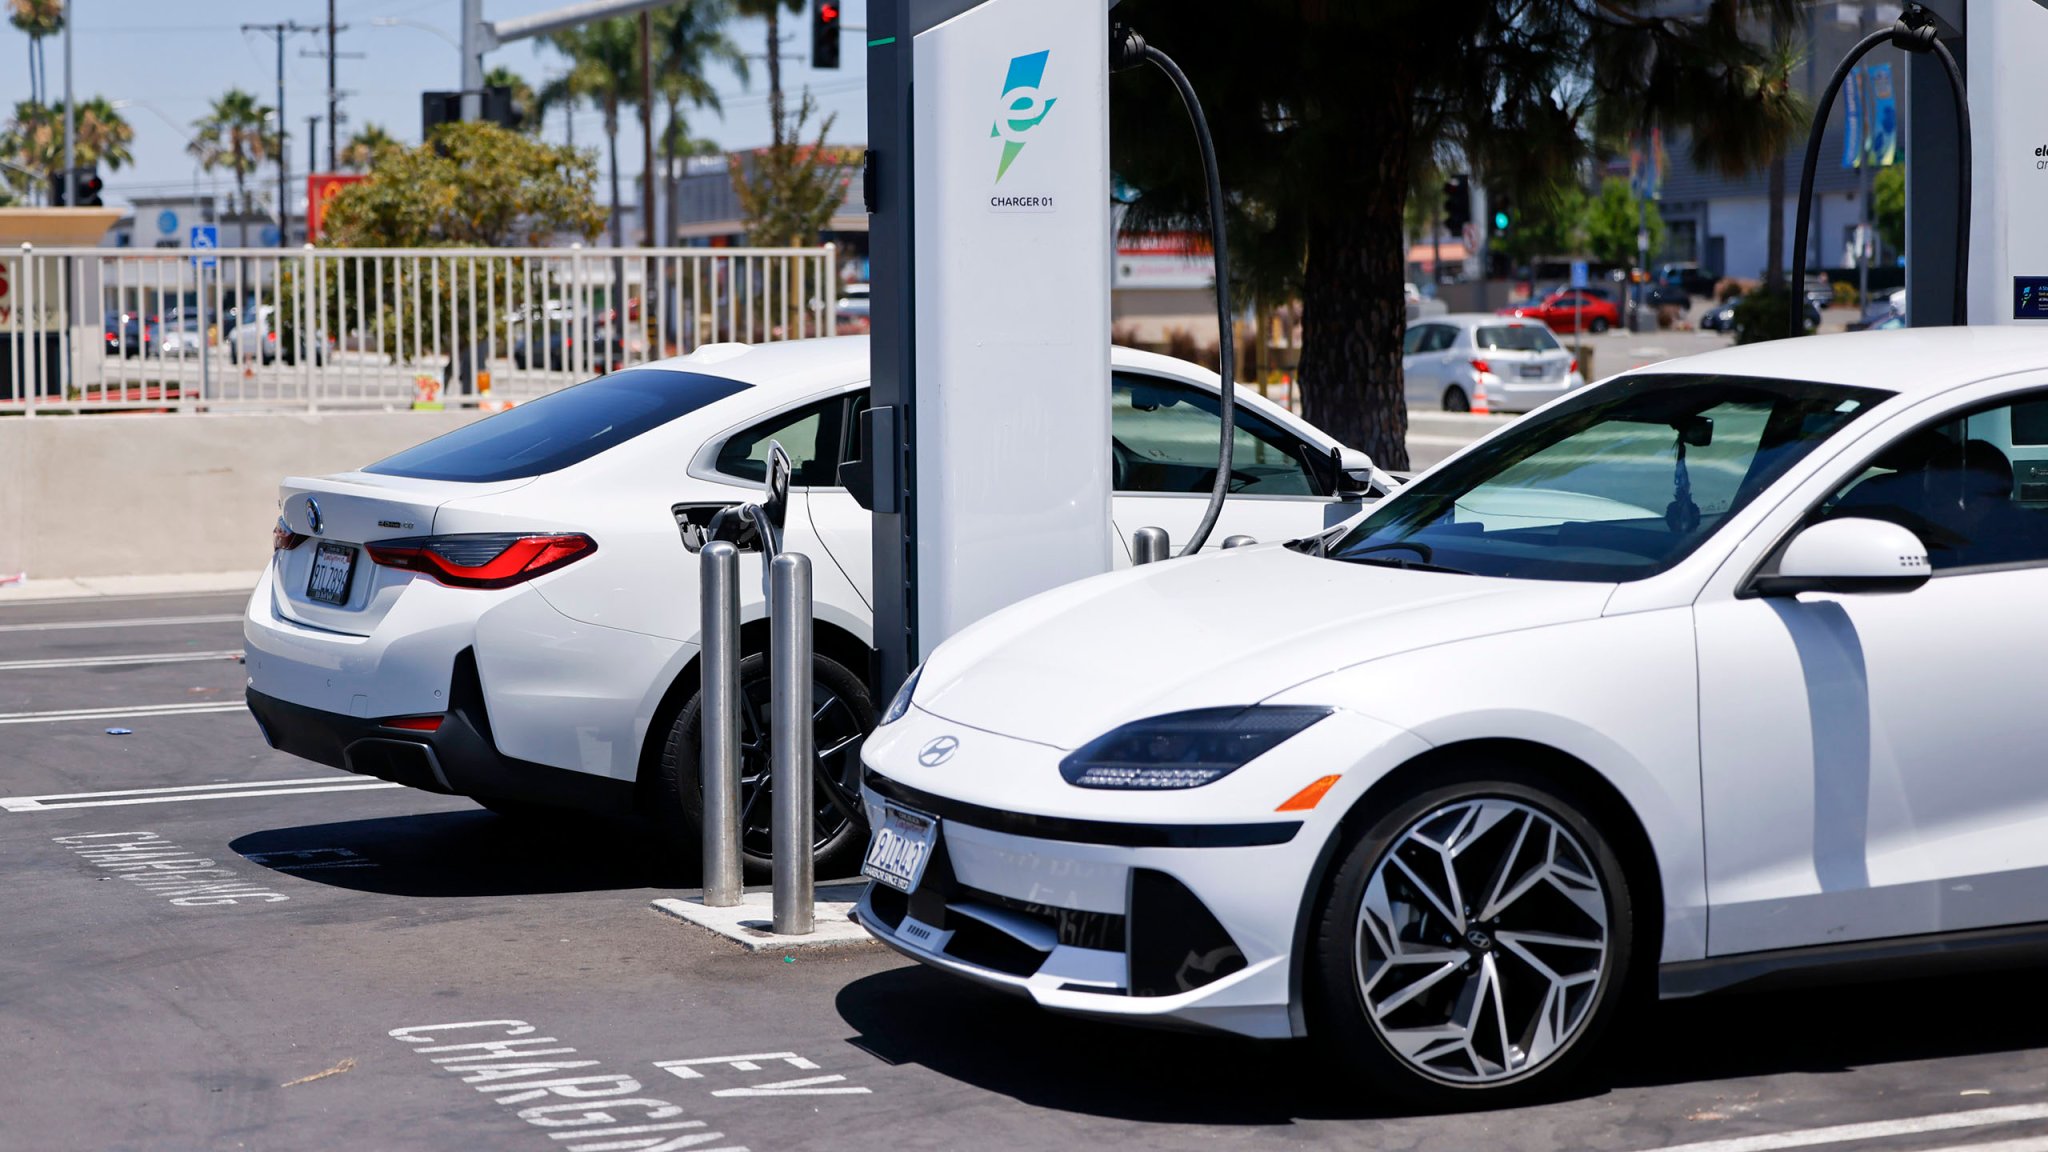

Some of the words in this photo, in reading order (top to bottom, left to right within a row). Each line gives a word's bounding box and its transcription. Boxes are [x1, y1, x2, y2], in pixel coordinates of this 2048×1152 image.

[990, 197, 1039, 206] CHARGER
[1041, 197, 1052, 206] 01
[52, 831, 290, 906] CHARGING
[652, 1051, 872, 1098] EV
